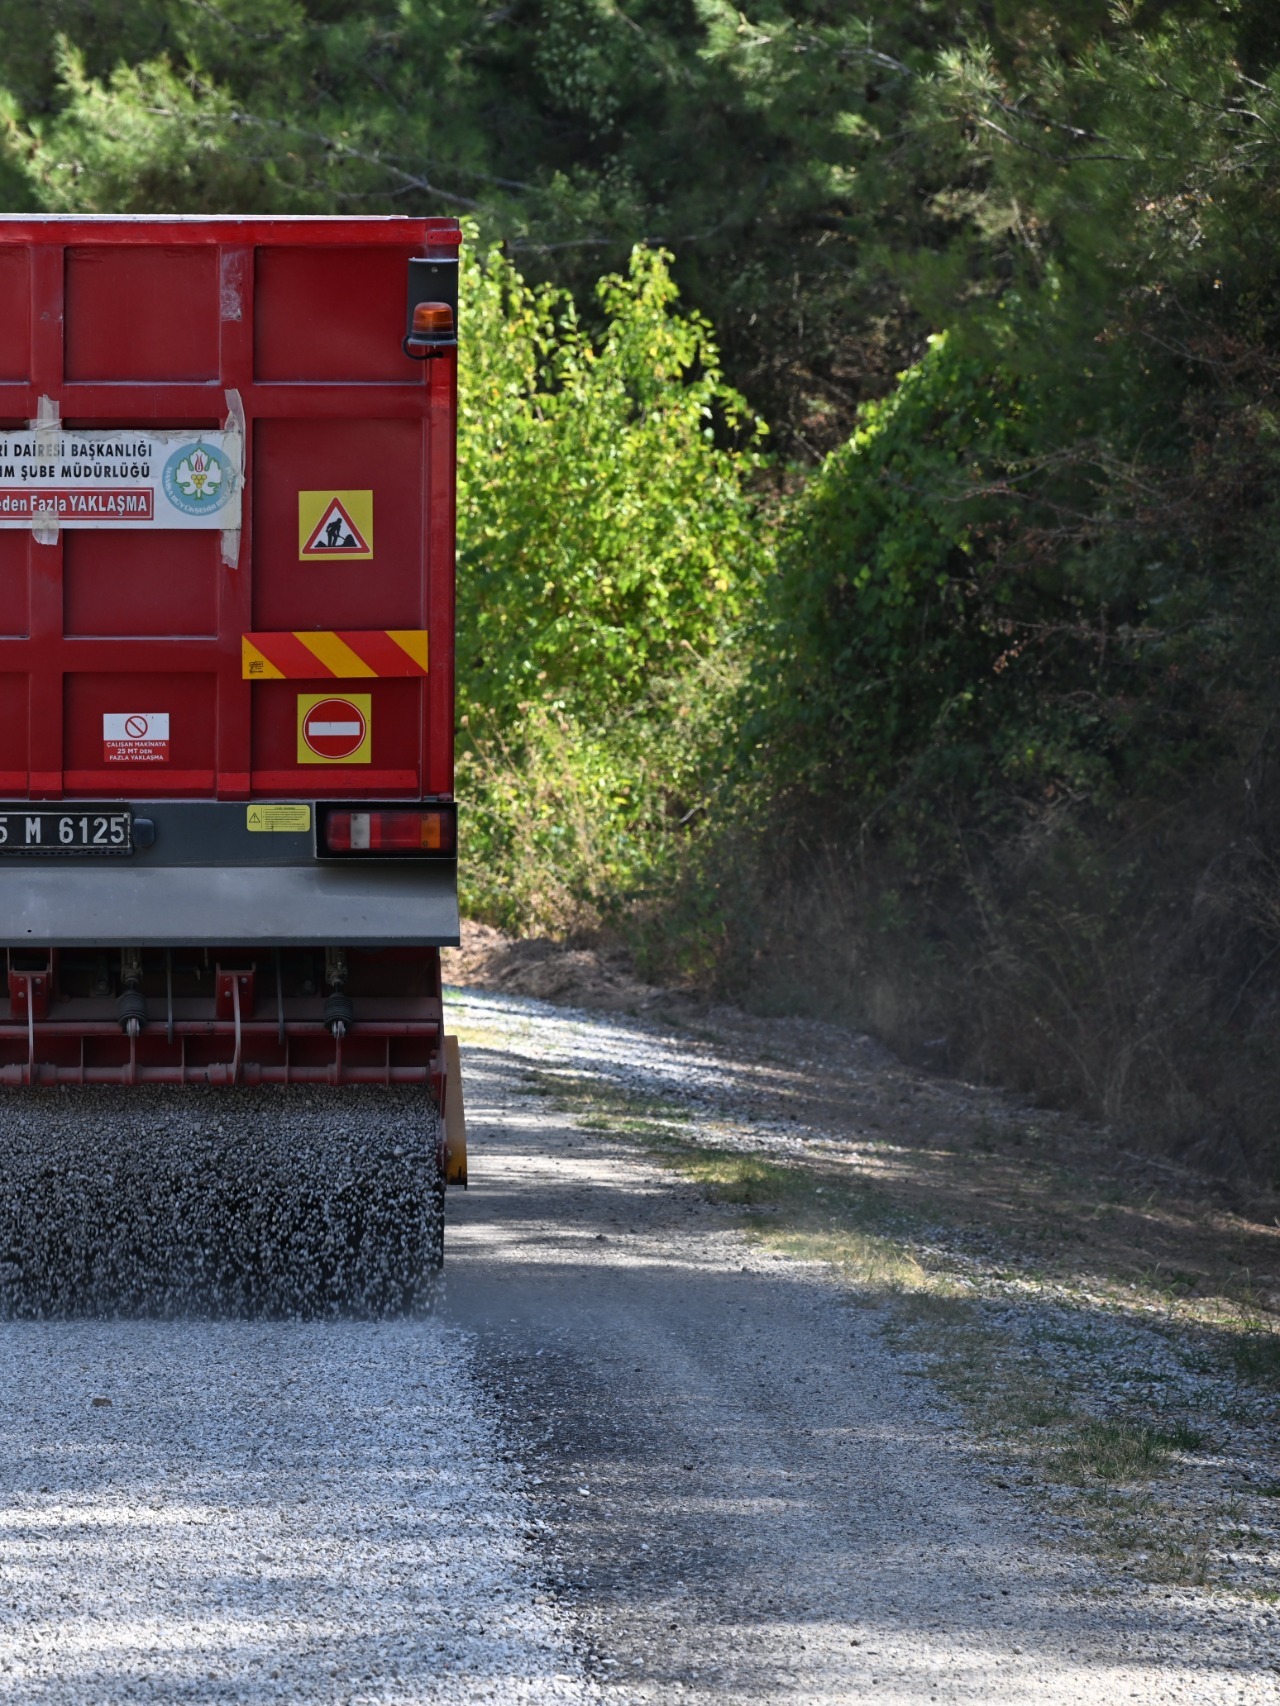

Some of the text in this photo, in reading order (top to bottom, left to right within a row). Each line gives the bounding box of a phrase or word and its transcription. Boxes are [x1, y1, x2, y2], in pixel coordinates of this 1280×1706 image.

[14, 440, 65, 457] DAİRESİ
[71, 440, 152, 461] BAŞKANLIĞI
[21, 465, 55, 481] ŞUBE
[61, 462, 150, 478] MÜDÜRLÜĞÜ
[30, 495, 67, 512] Fazla
[69, 495, 148, 516] YAKLAŞMA
[25, 817, 41, 844] M
[58, 817, 125, 844] 6125
